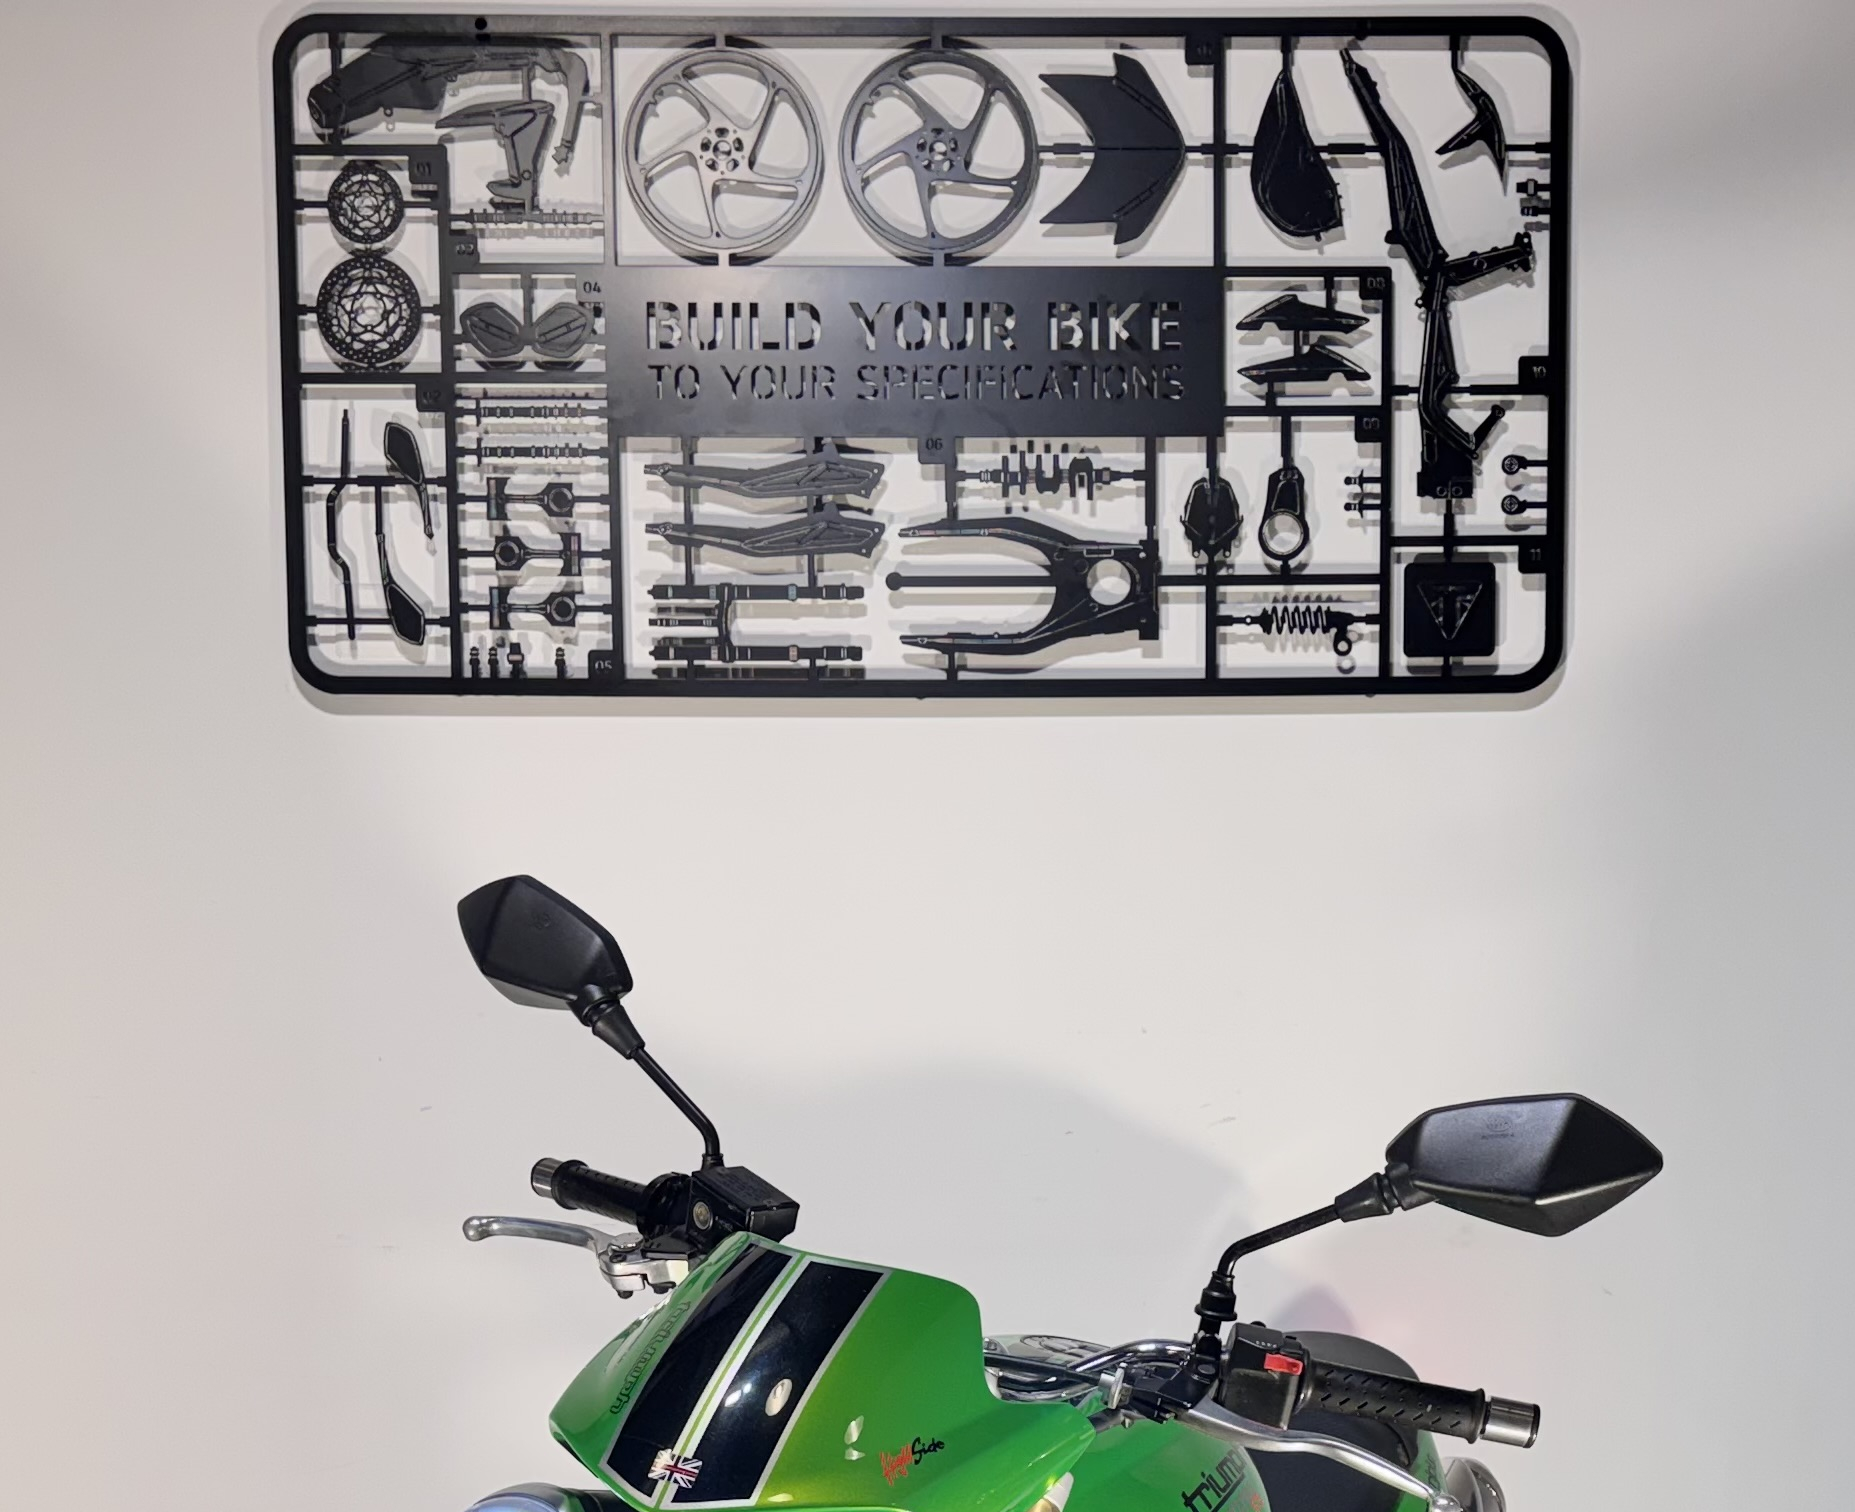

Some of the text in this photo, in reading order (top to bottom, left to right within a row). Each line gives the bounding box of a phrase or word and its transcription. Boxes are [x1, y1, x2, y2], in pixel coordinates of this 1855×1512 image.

[583, 281, 601, 294] 04
[646, 301, 1183, 351] BUILD YOUR BIKE
[647, 363, 1185, 400] TO YOUR SPECIFICATIONS
[926, 438, 943, 451] 06
